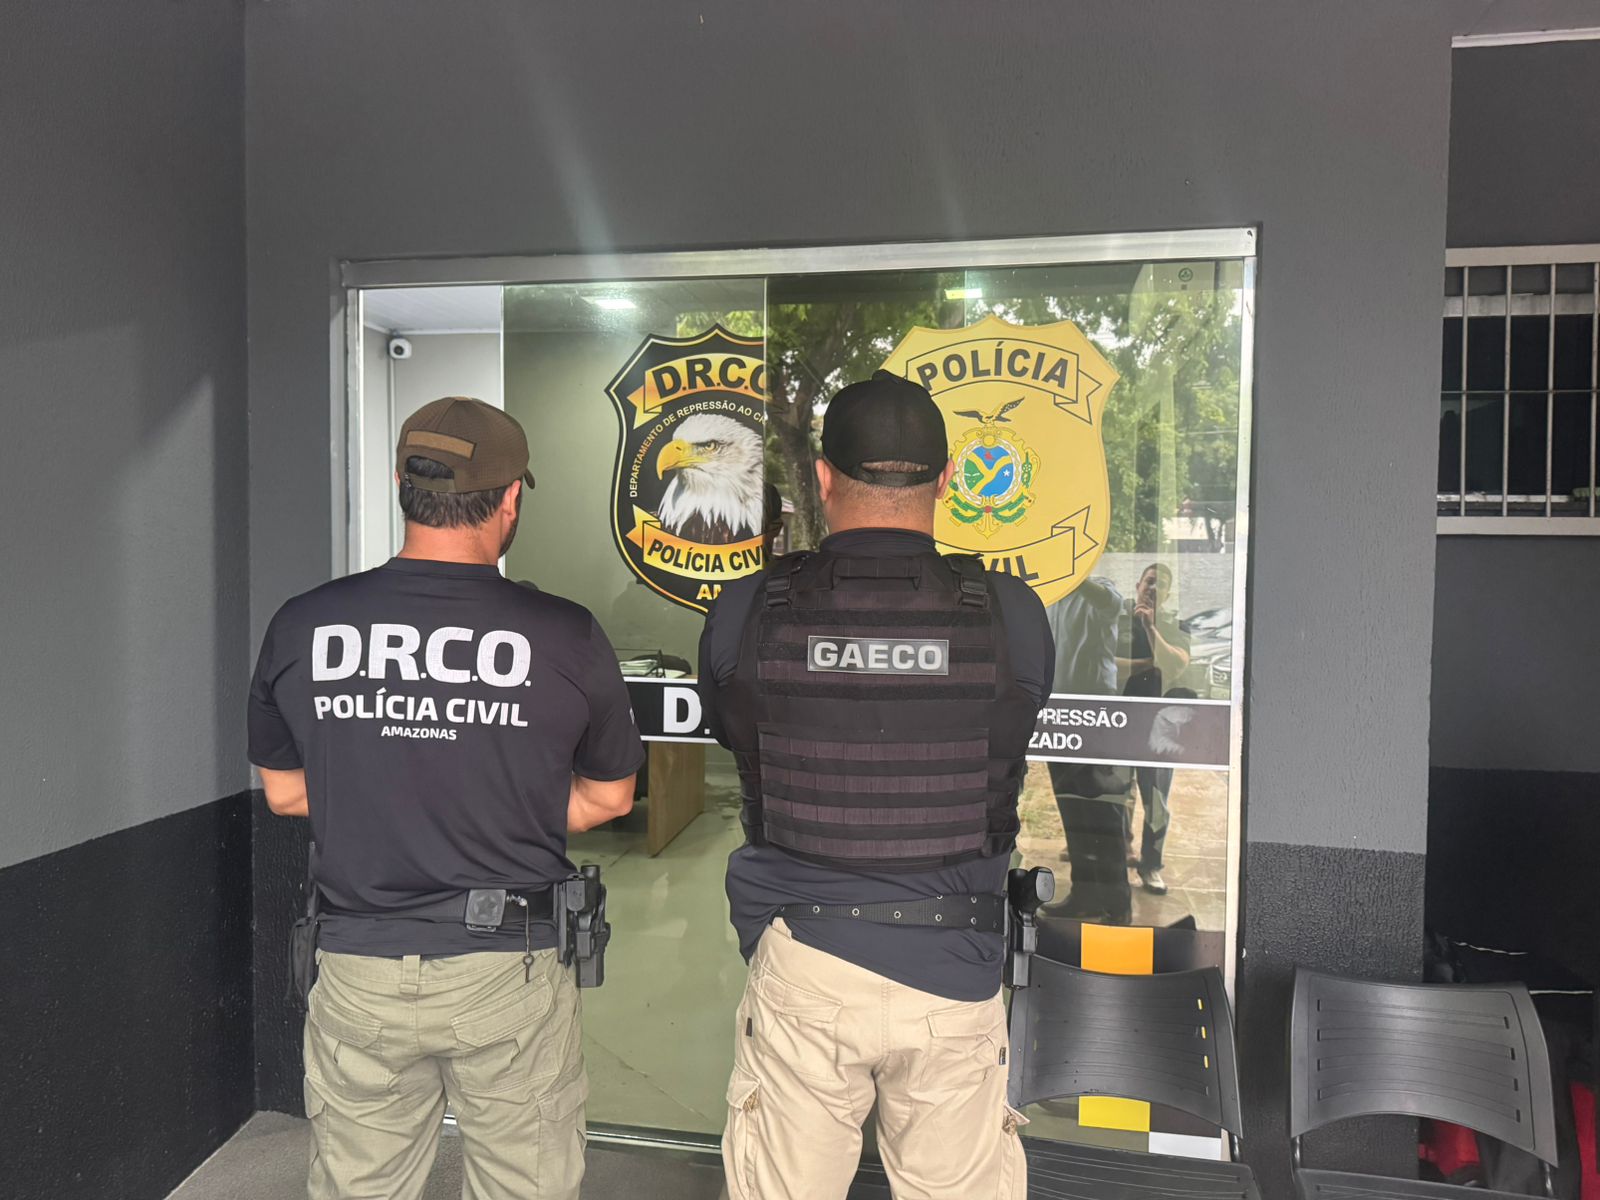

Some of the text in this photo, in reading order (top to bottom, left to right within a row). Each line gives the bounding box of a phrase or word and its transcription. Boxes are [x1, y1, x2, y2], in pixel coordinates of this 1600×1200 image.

[916, 341, 1069, 391] POLÍCIA
[629, 424, 663, 498] DEPARTAMENTO
[663, 413, 677, 427] DE
[677, 400, 736, 418] REPRESSÃO
[737, 405, 752, 417] AO
[647, 538, 763, 573] POLÍCIA CIV
[312, 623, 531, 687] D.R.C.O.
[813, 641, 942, 670] GAECO
[314, 687, 528, 727] POLÍCIA CIVIL
[381, 726, 457, 740] AMAZONAS
